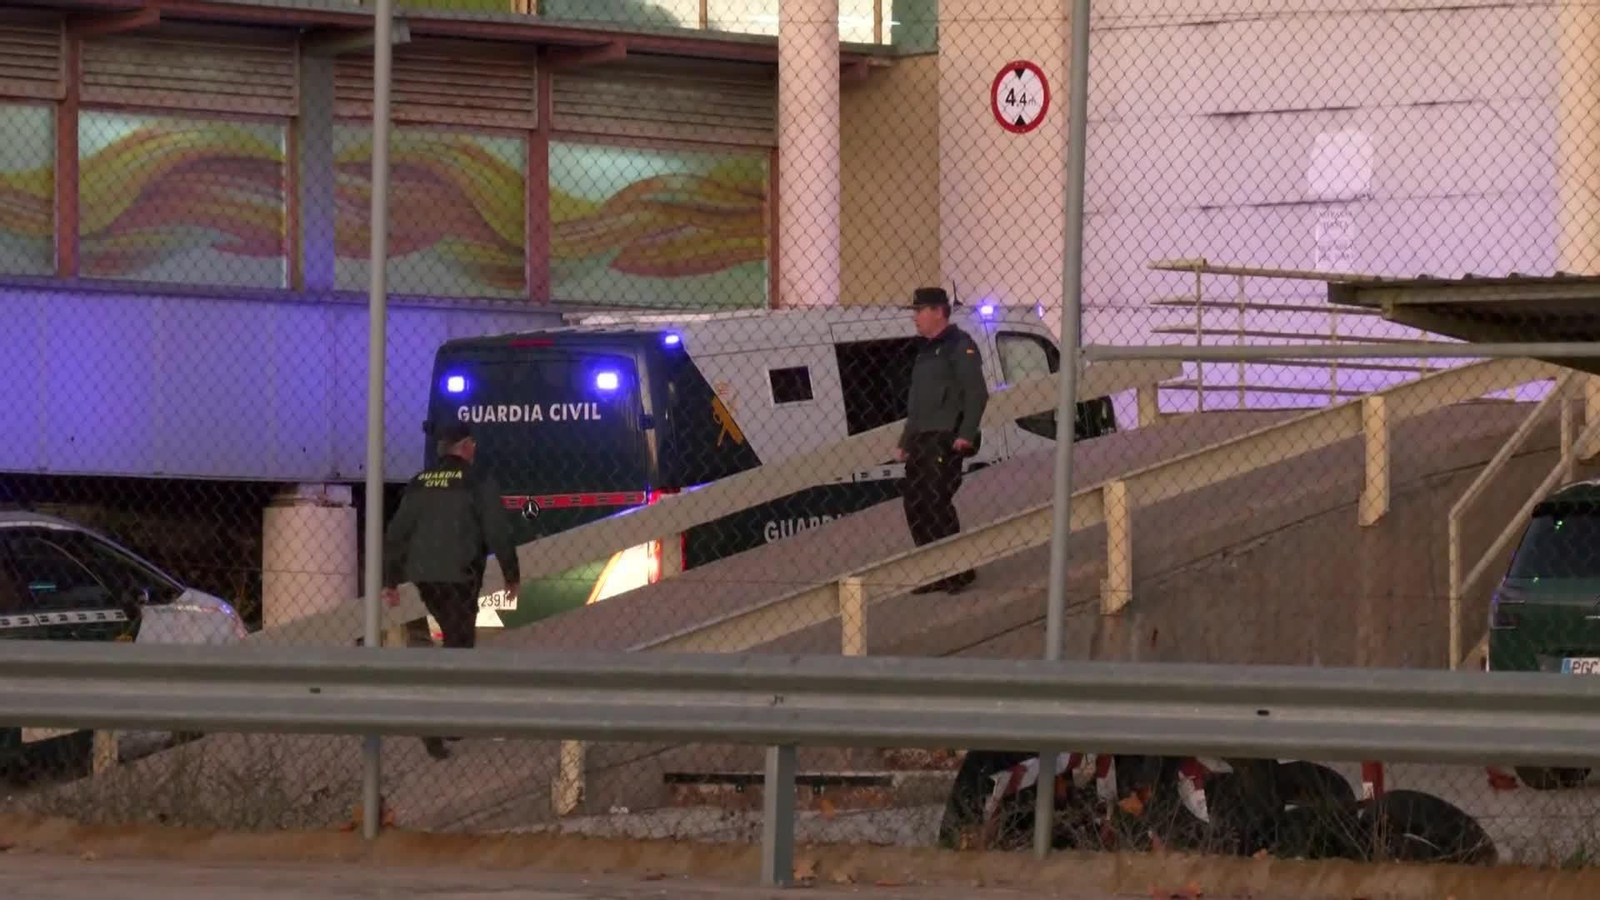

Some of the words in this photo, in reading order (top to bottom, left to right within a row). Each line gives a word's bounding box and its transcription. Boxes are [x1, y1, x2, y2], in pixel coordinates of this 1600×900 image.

[457, 404, 544, 424] GUARDIA
[549, 402, 602, 421] CIVIL
[418, 470, 463, 480] GUARDIA
[425, 479, 449, 488] CIVIL
